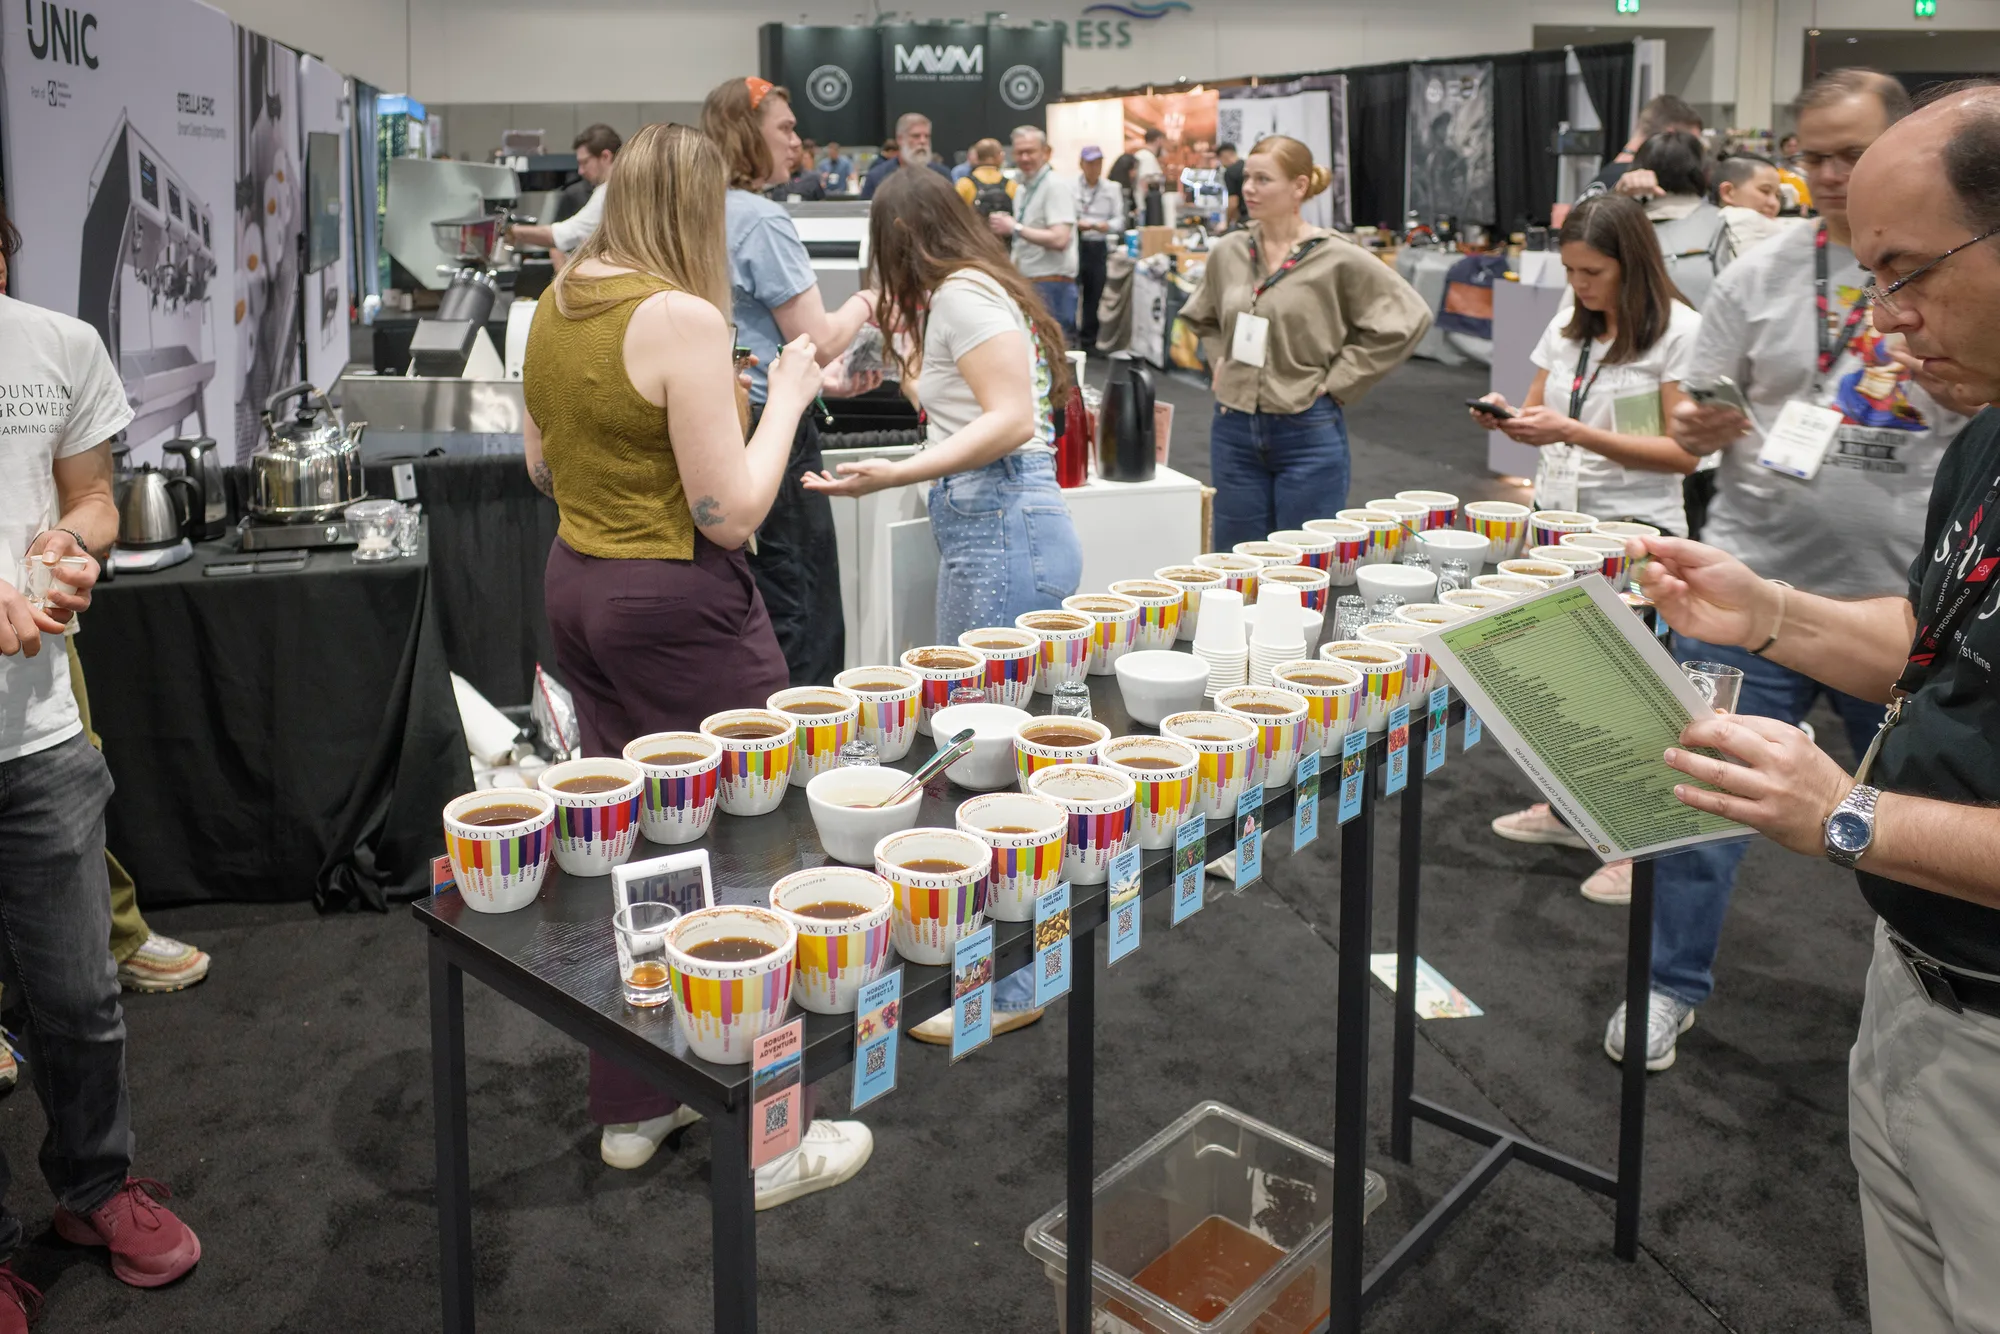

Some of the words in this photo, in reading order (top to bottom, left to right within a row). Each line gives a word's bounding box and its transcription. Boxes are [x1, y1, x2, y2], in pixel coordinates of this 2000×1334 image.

[26, 0, 99, 70] UNIC
[177, 92, 200, 114] STELLA
[201, 95, 215, 116] EPIC
[1933, 587, 1971, 639] STRONGHOLD
[1973, 651, 1991, 672] time
[925, 671, 976, 679] COFFEE
[880, 690, 916, 702] GOLD
[798, 712, 856, 726] ROWERS
[1016, 741, 1083, 758] GROWERS
[1514, 747, 1540, 779] GROWERS
[1129, 766, 1198, 781] GROWERS
[1539, 775, 1559, 799] COFFEE
[1556, 796, 1586, 828] MOUNTAIN
[457, 820, 545, 839] MOUNTAIN
[1584, 826, 1600, 844] GOLD
[1042, 895, 1064, 909] SUMATRA?
[1043, 894, 1052, 903] THIS
[956, 935, 991, 956] MICROECONOMICS
[668, 955, 757, 979] GROWERS
[865, 989, 887, 1004] PERFECT
[866, 979, 893, 996] NOBODY'S
[760, 1036, 797, 1059] ADVENTURE
[763, 1030, 793, 1048] ROBUSTA
